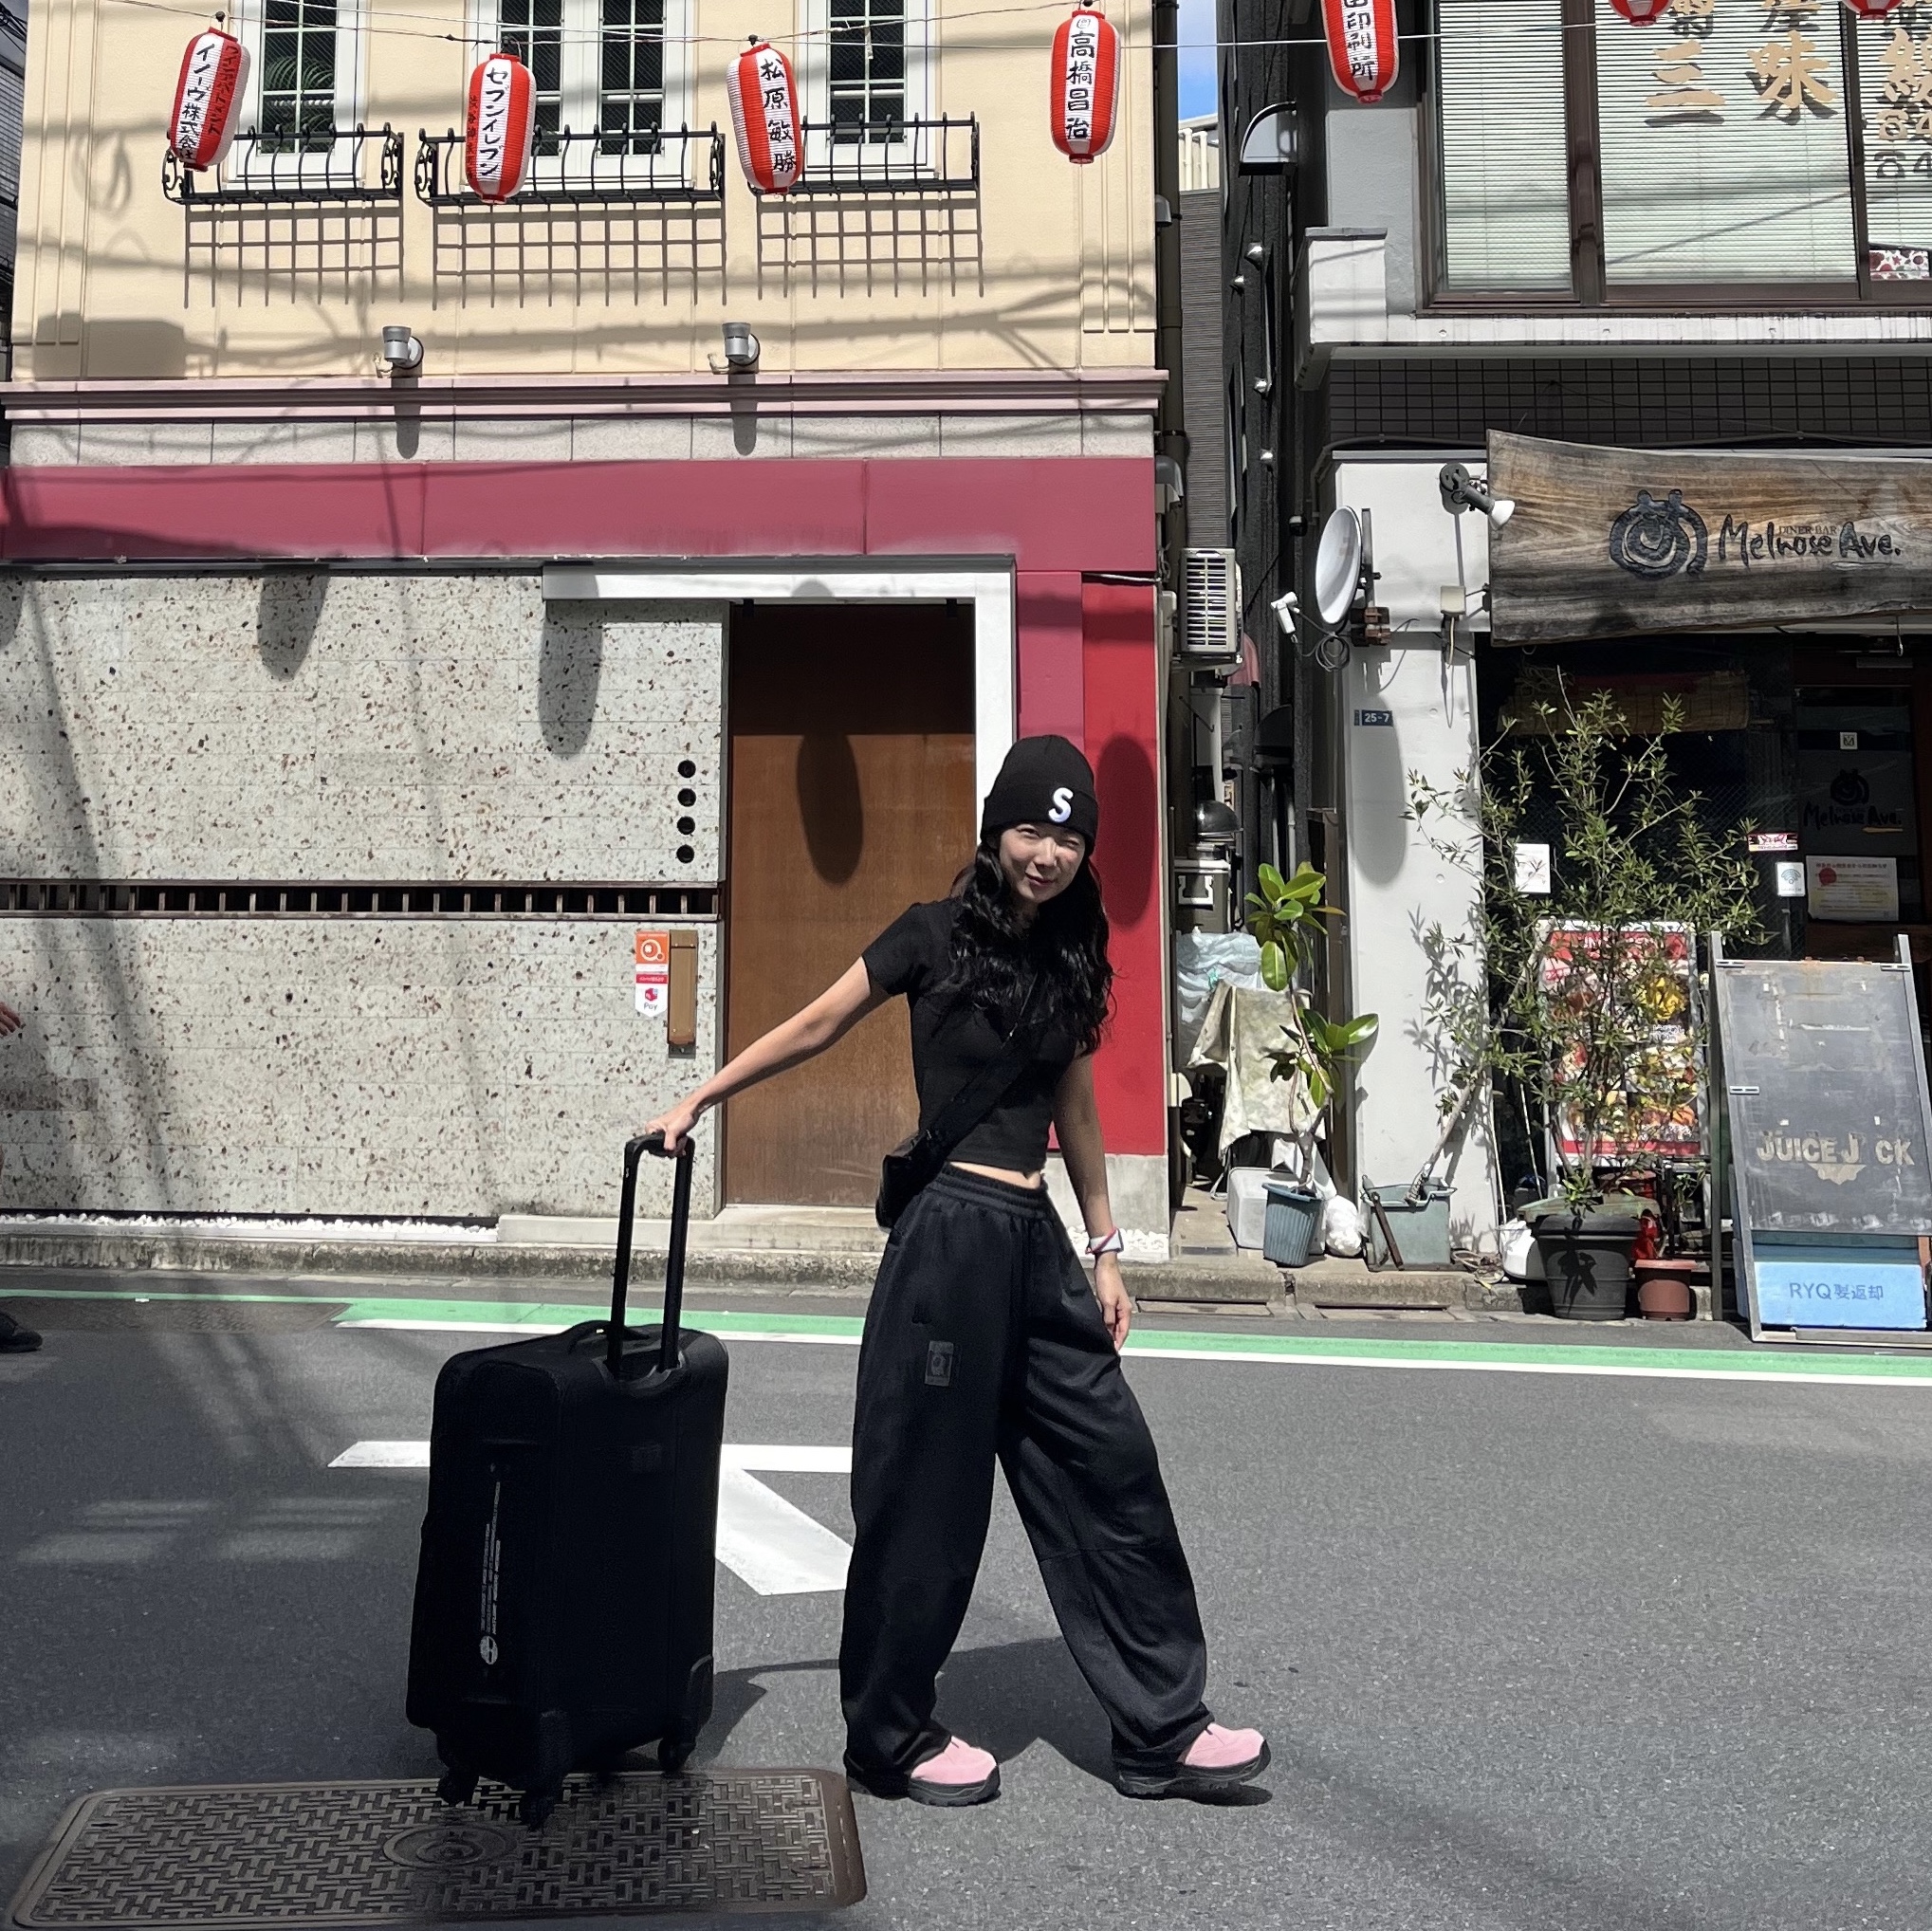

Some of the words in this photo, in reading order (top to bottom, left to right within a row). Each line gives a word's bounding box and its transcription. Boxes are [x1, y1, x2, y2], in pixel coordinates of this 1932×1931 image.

[1065, 30, 1095, 140] 高橋昌治
[479, 66, 510, 176] セブンイレブン
[760, 58, 797, 173] 松原敏勝
[1718, 513, 1832, 569] Melrose
[1839, 521, 1901, 558] Ave.
[1778, 525, 1812, 535] DINER
[1815, 525, 1837, 535] BAR
[1364, 712, 1389, 723] 25-7
[1048, 787, 1074, 822] S
[644, 1002, 658, 1011] Pay
[1756, 1133, 1837, 1163] JUICE
[1840, 1133, 1916, 1166] JCK
